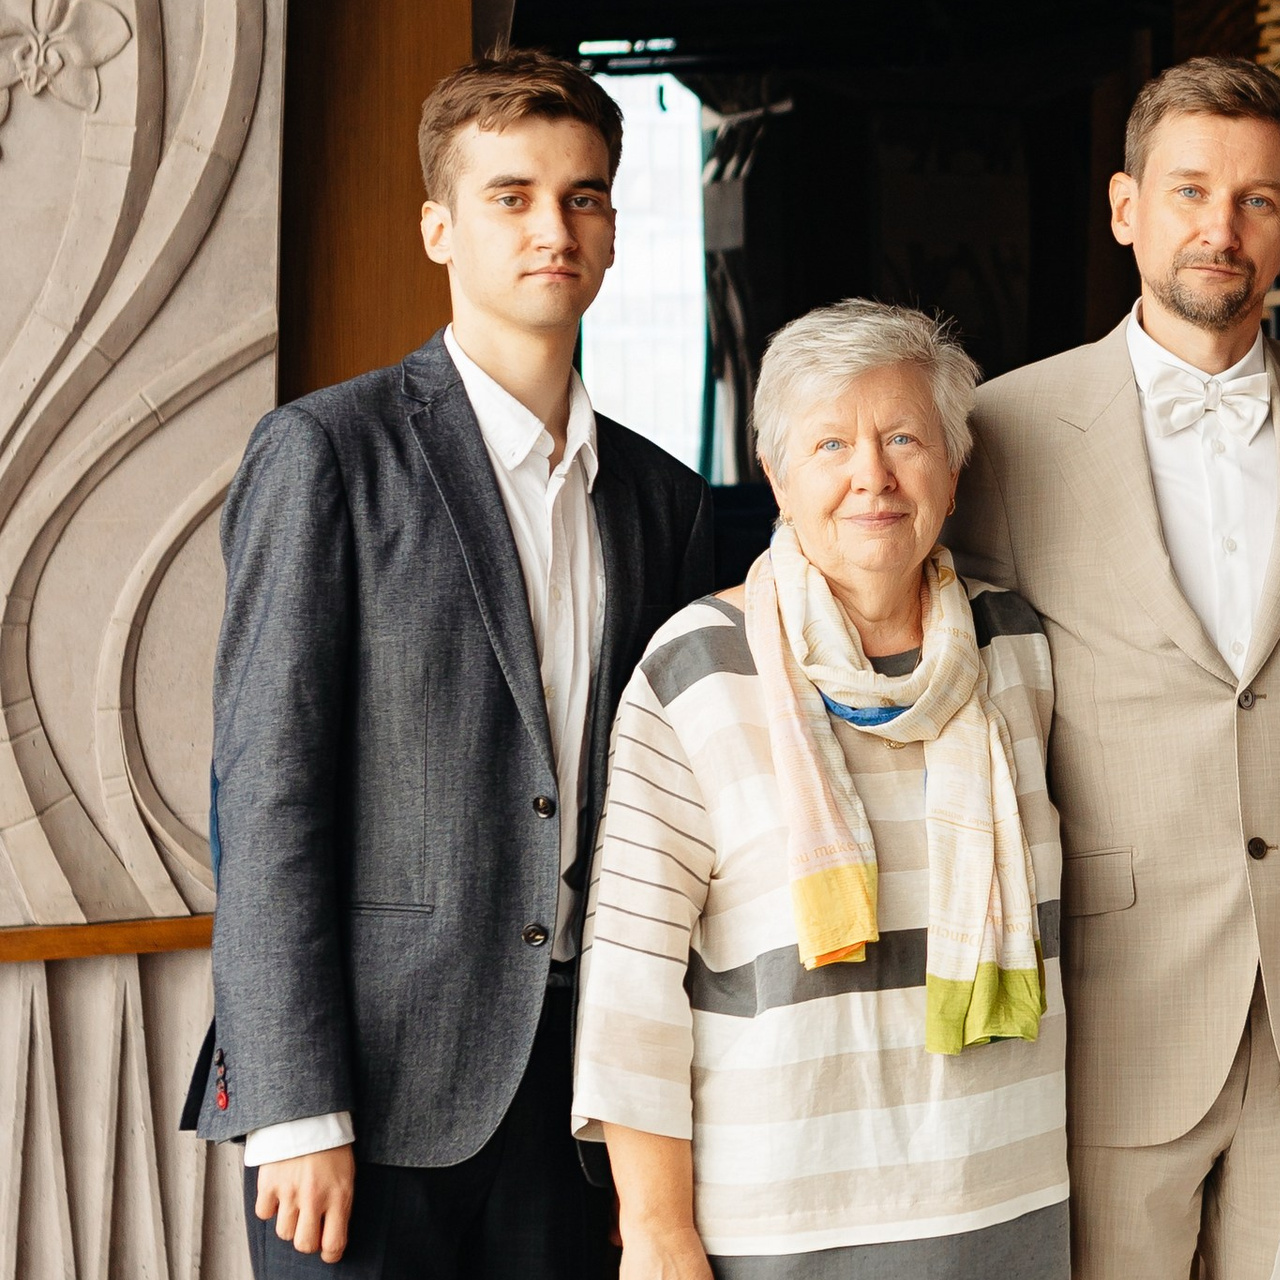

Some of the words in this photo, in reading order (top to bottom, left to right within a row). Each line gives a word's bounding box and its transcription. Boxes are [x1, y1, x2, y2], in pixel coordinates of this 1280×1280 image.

[790, 852, 810, 867] ou
[812, 839, 856, 858] make
[929, 923, 981, 947] Dancin
